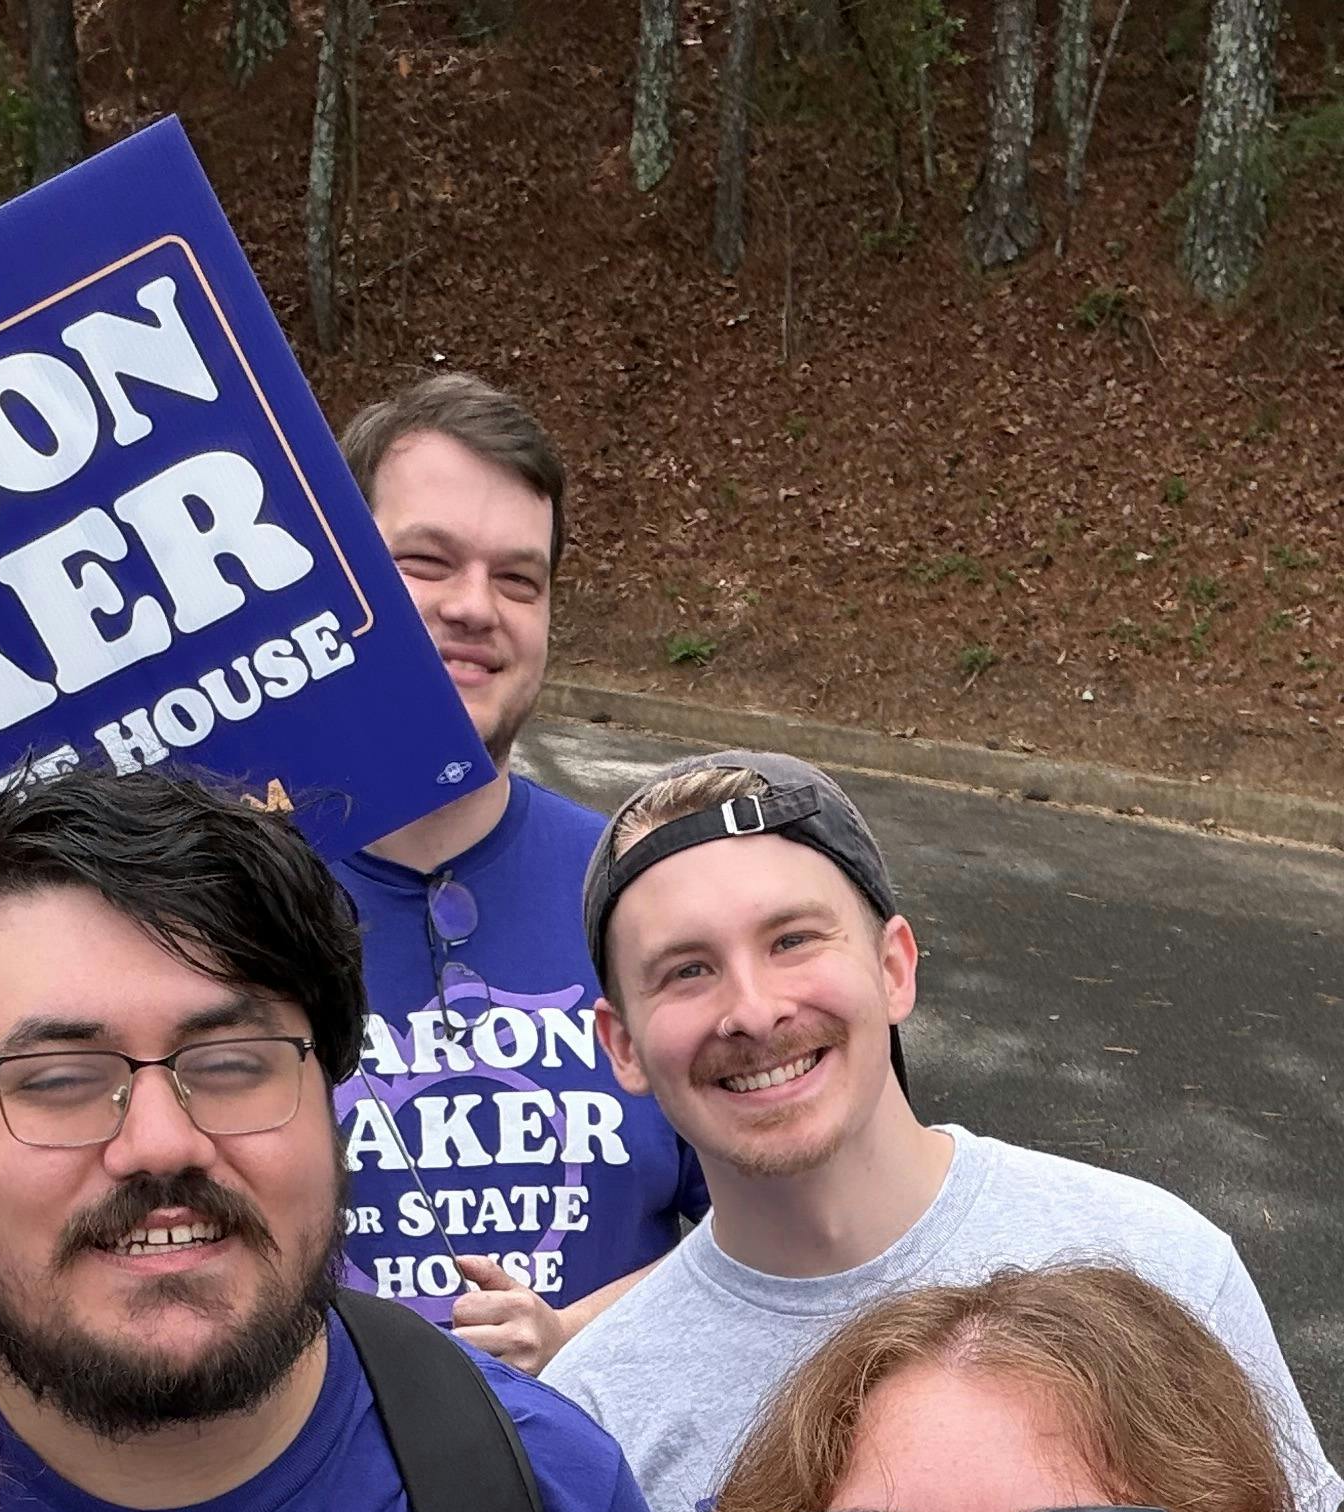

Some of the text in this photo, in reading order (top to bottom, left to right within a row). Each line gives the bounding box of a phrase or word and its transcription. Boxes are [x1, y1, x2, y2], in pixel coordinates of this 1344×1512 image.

[94, 610, 358, 778] HOUSE
[357, 1006, 597, 1076] ARON
[345, 1089, 630, 1172] AKER
[397, 1184, 590, 1237] STATE
[373, 1250, 564, 1299] HOSE
